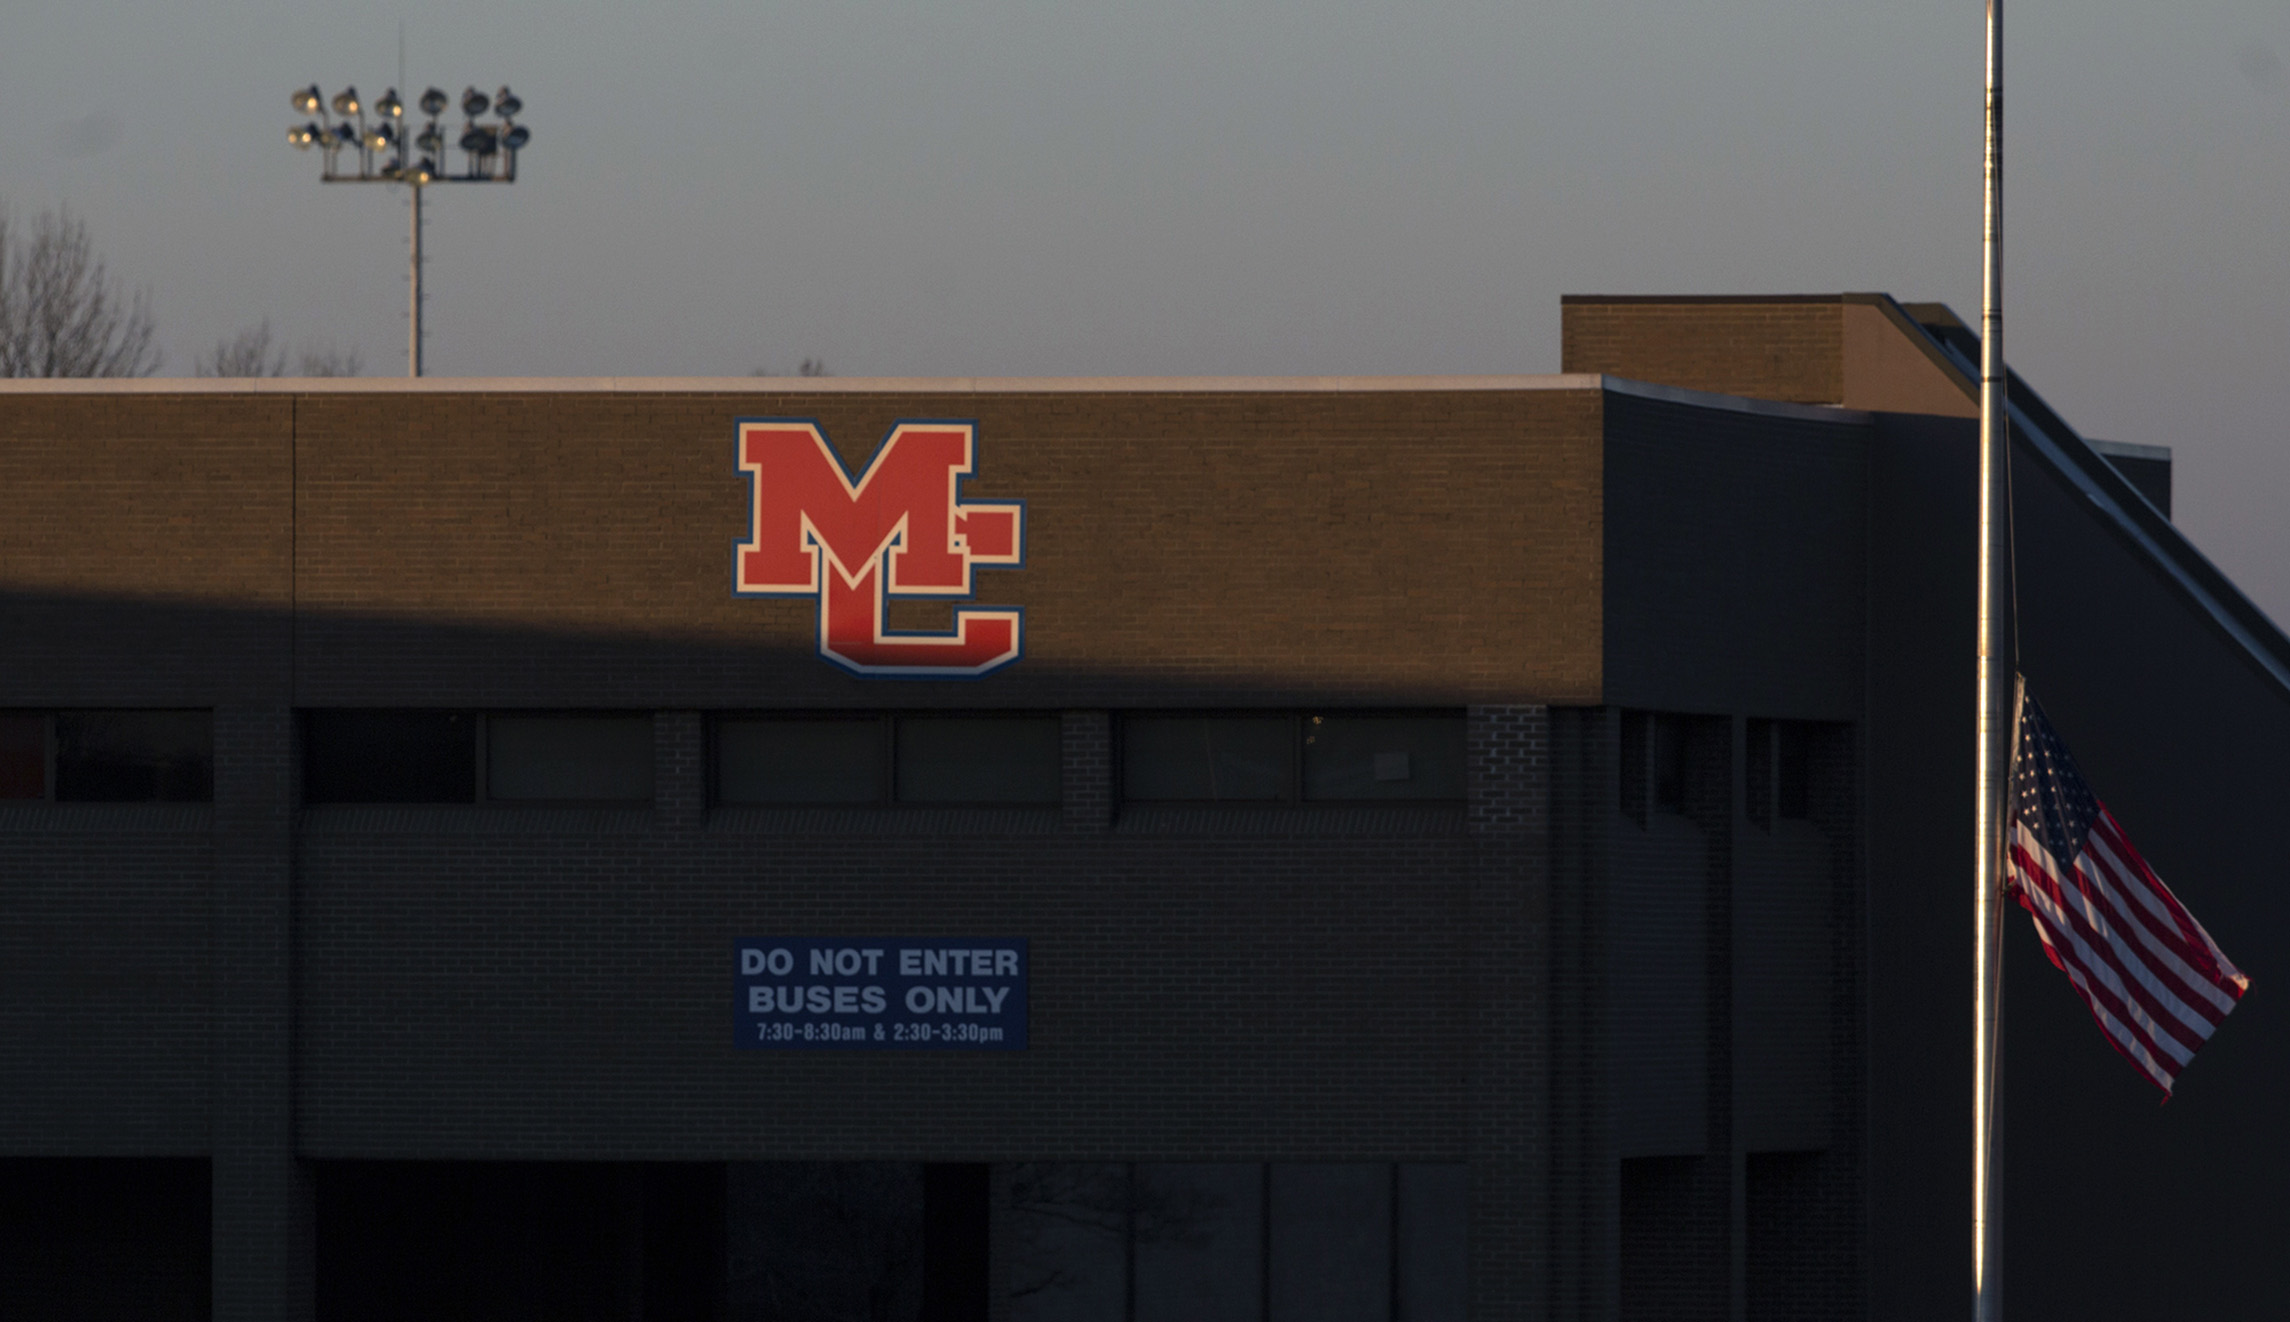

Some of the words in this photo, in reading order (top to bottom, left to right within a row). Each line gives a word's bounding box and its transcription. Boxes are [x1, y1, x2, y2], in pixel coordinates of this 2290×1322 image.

[741, 948, 794, 976] DO
[810, 948, 884, 976] NOT
[899, 948, 1019, 976] ENTER
[749, 985, 887, 1013] BUSES
[905, 985, 1010, 1013] ONLY
[757, 1022, 866, 1041] 7:30-8:30am
[873, 1022, 886, 1041] &
[893, 1022, 1003, 1043] 2:30-3:30pm
